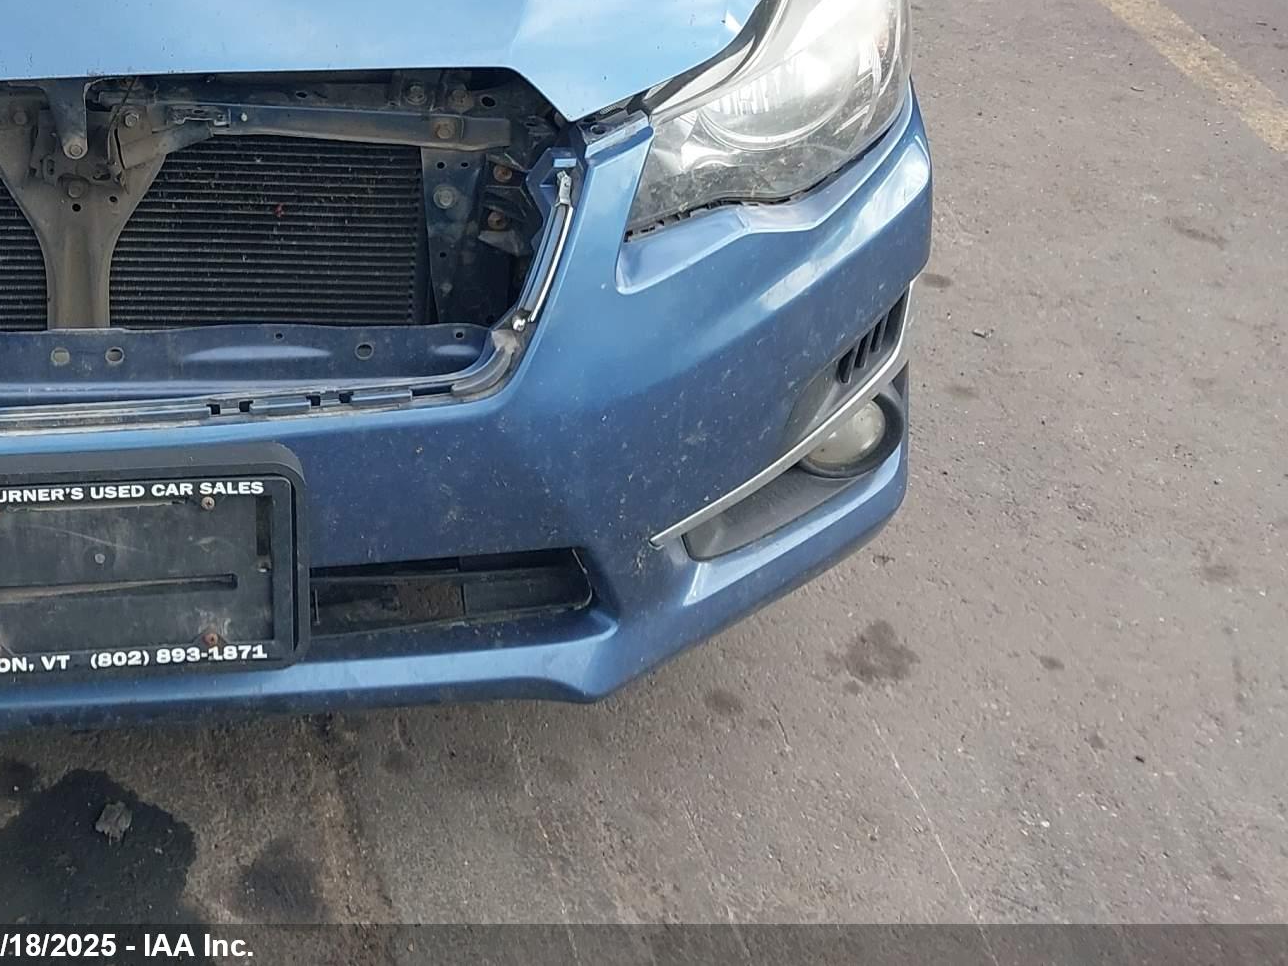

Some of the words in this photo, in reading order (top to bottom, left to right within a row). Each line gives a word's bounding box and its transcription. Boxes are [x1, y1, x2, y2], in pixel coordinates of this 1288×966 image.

[90, 484, 145, 500] USED
[151, 482, 194, 497] CAR
[199, 481, 264, 496] SALES
[40, 654, 71, 671] VT
[90, 650, 150, 669] (802)
[156, 644, 268, 664] 893-1871
